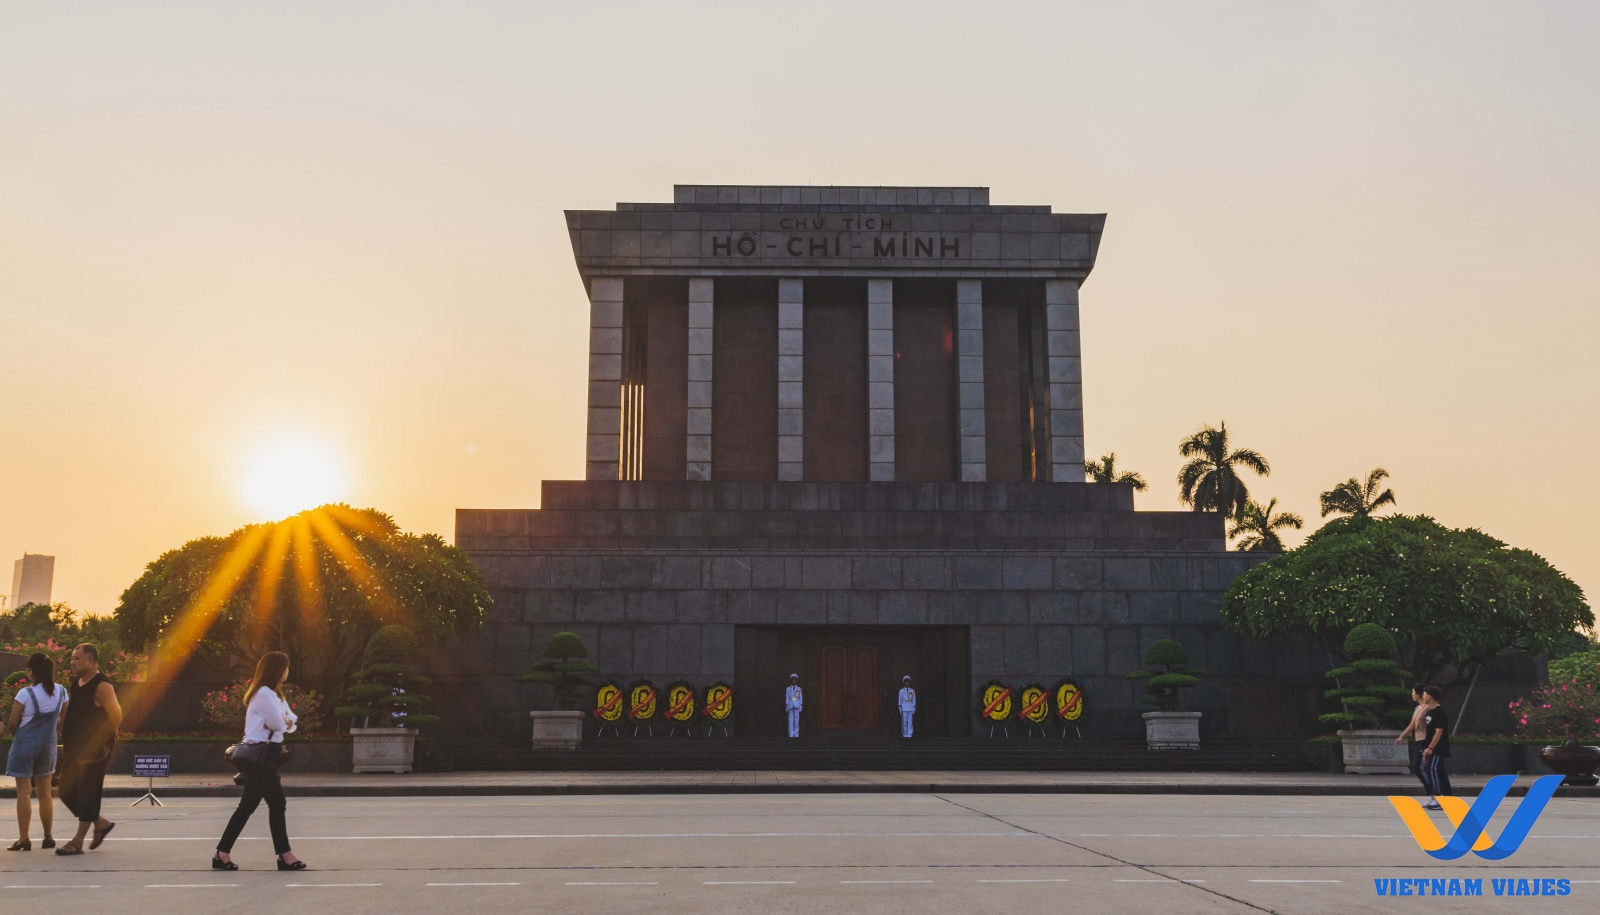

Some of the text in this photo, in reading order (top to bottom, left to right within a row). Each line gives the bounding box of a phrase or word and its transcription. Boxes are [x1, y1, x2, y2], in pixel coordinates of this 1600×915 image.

[780, 213, 824, 230] CHỦ
[712, 231, 757, 257] HỒ
[786, 232, 841, 257] CHÍ
